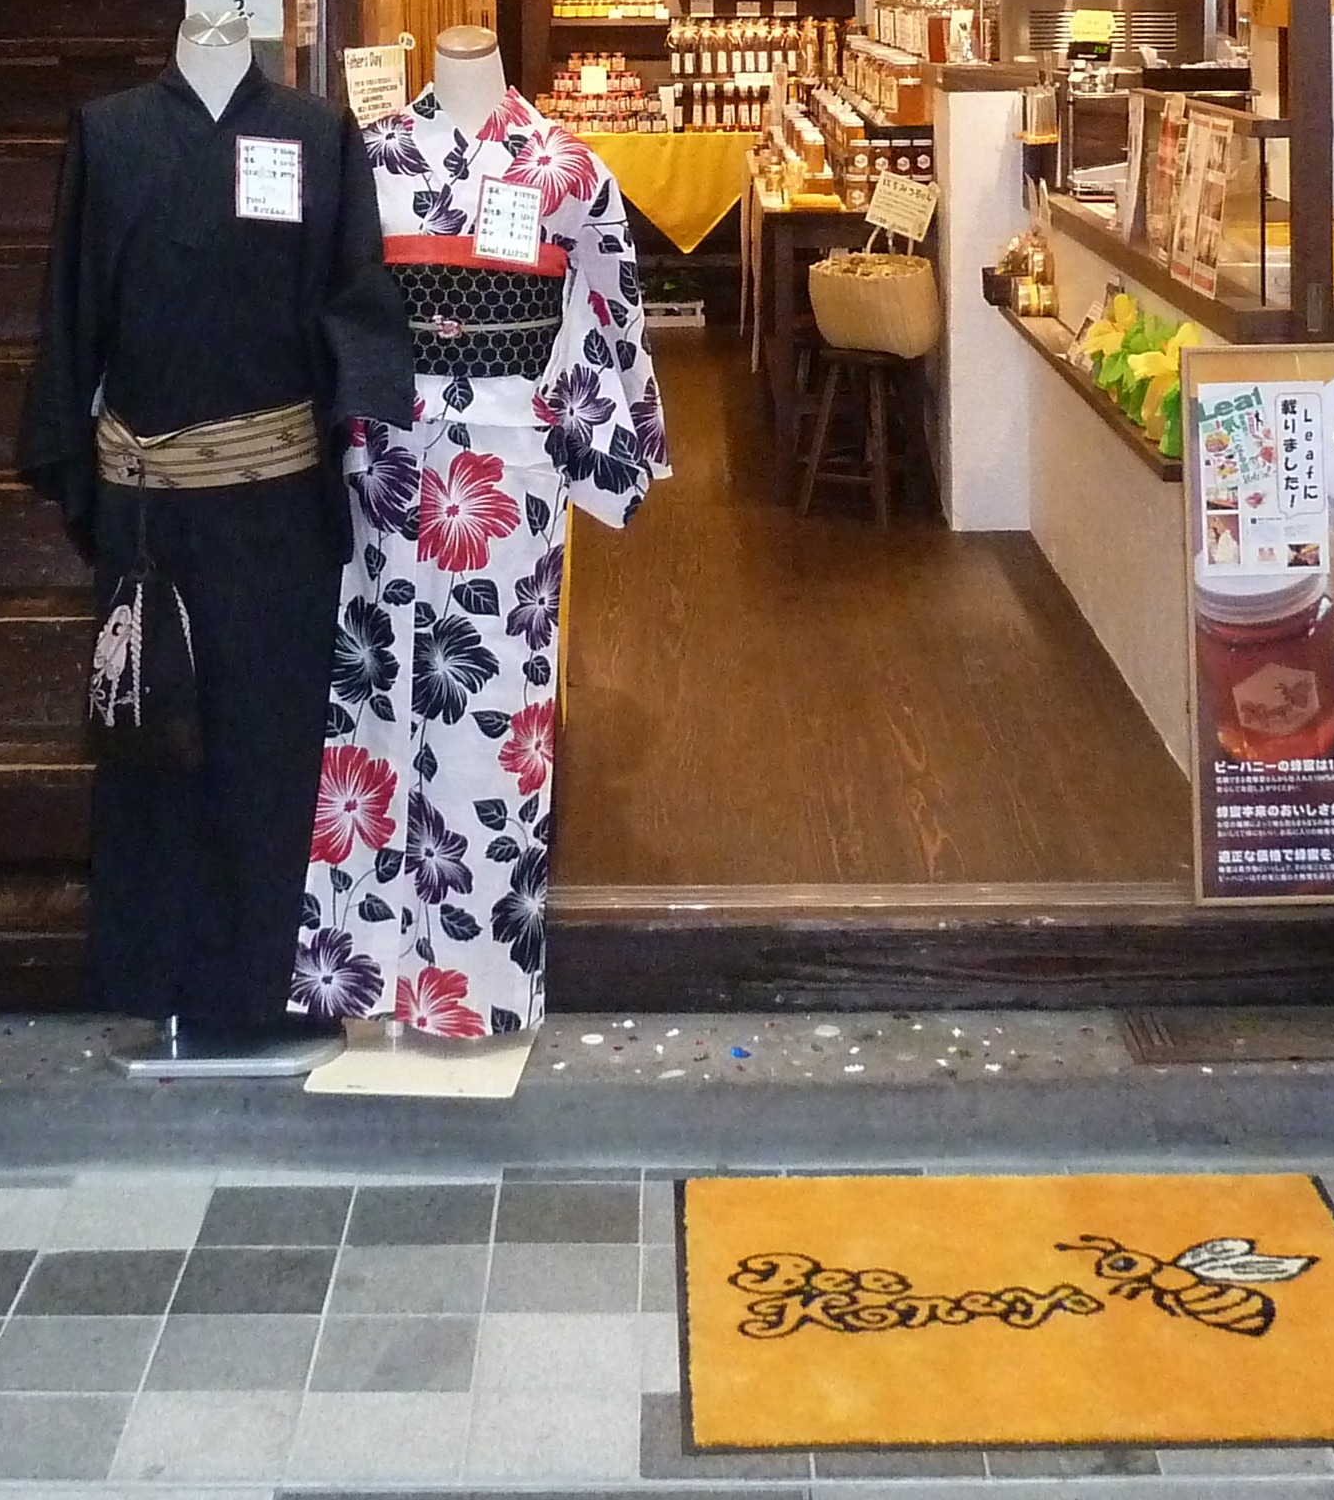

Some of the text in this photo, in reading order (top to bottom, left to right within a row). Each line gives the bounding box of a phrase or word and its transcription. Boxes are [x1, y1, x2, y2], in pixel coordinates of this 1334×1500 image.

[1281, 398, 1300, 509] 載りました!
[1303, 408, 1318, 500] Leafに
[726, 1252, 912, 1294] Bee
[736, 1284, 1091, 1340] Honey
